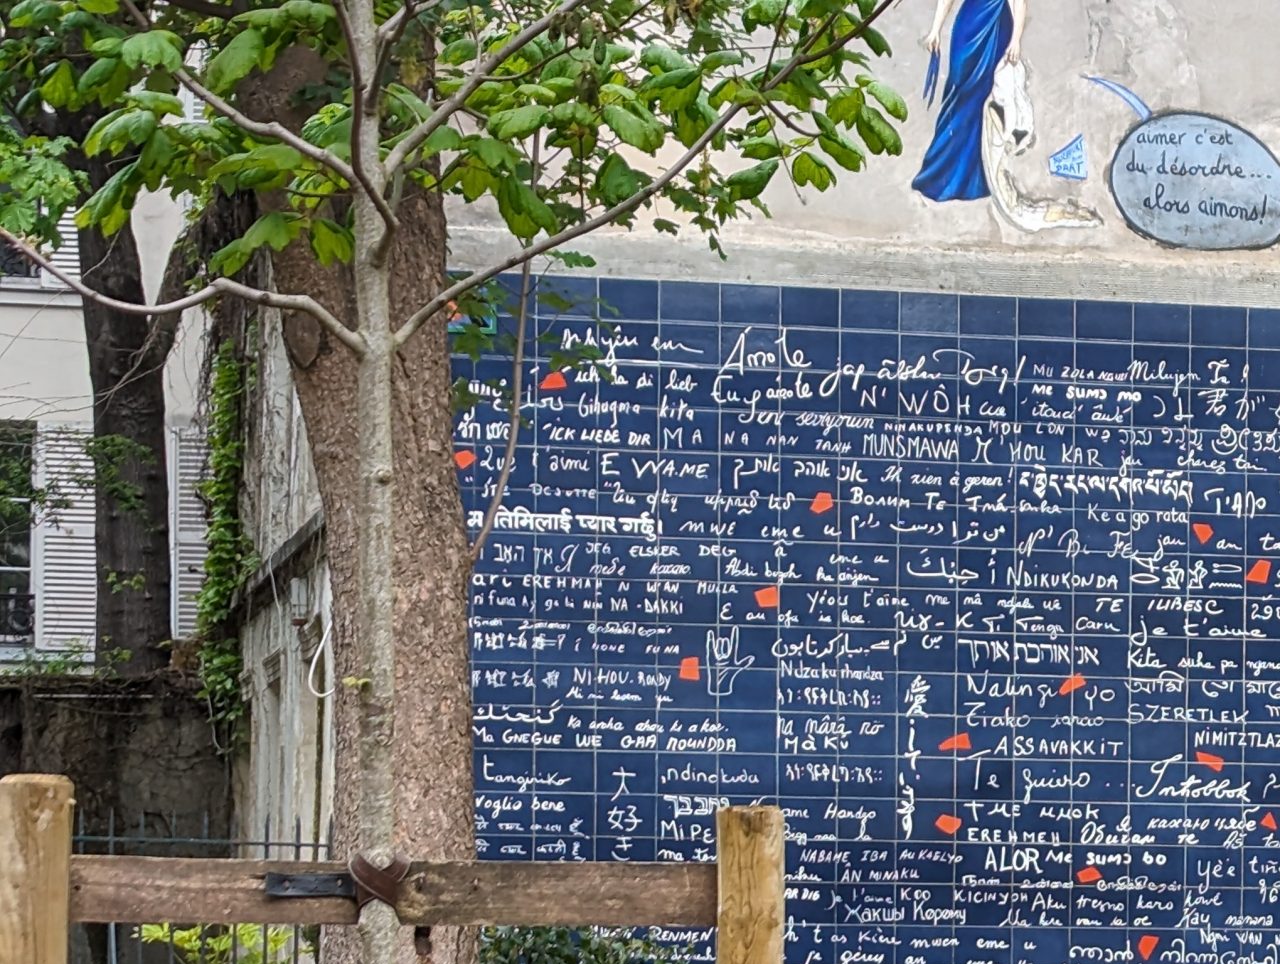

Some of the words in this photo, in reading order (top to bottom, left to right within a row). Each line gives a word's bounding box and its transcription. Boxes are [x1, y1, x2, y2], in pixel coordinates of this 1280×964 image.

[1137, 131, 1186, 146] aimer
[1195, 128, 1234, 146] c'est
[1126, 149, 1148, 173] du
[1144, 183, 1190, 215] alors
[1199, 194, 1267, 224] aimons!
